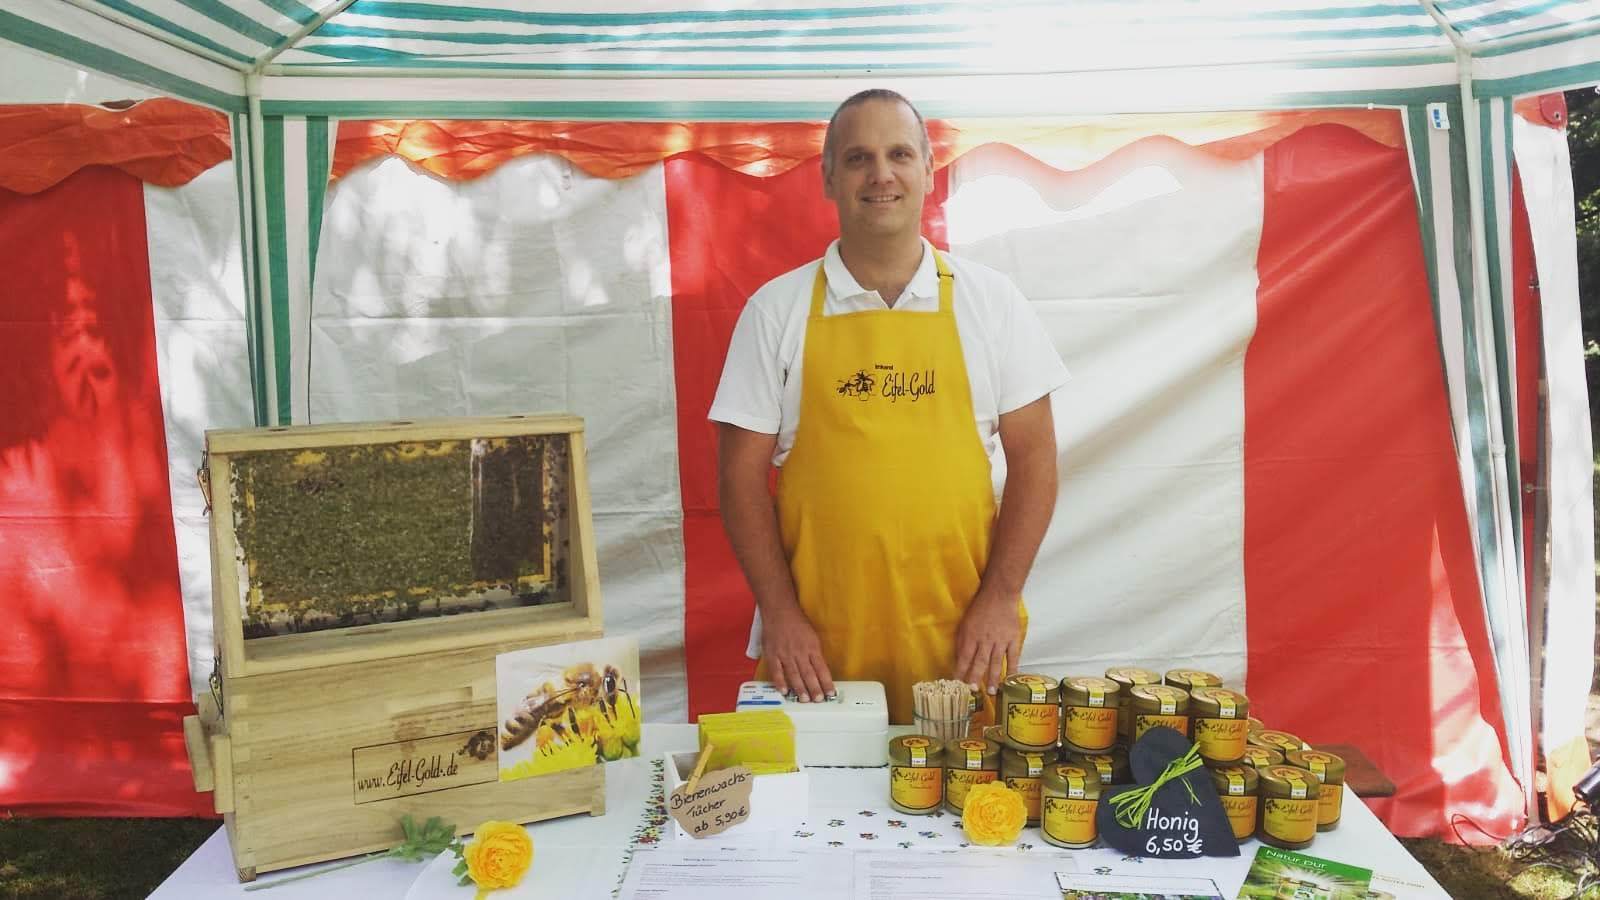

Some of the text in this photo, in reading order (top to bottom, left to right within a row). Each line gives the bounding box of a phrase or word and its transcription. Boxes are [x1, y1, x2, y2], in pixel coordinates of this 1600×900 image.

[882, 370, 935, 403] Eifel-Gold
[670, 772, 751, 809] Bienenwachs-
[686, 799, 726, 818] Tücher
[694, 820, 709, 833] ab
[1146, 807, 1199, 843] Honig
[1266, 849, 1328, 869] Natur pur
